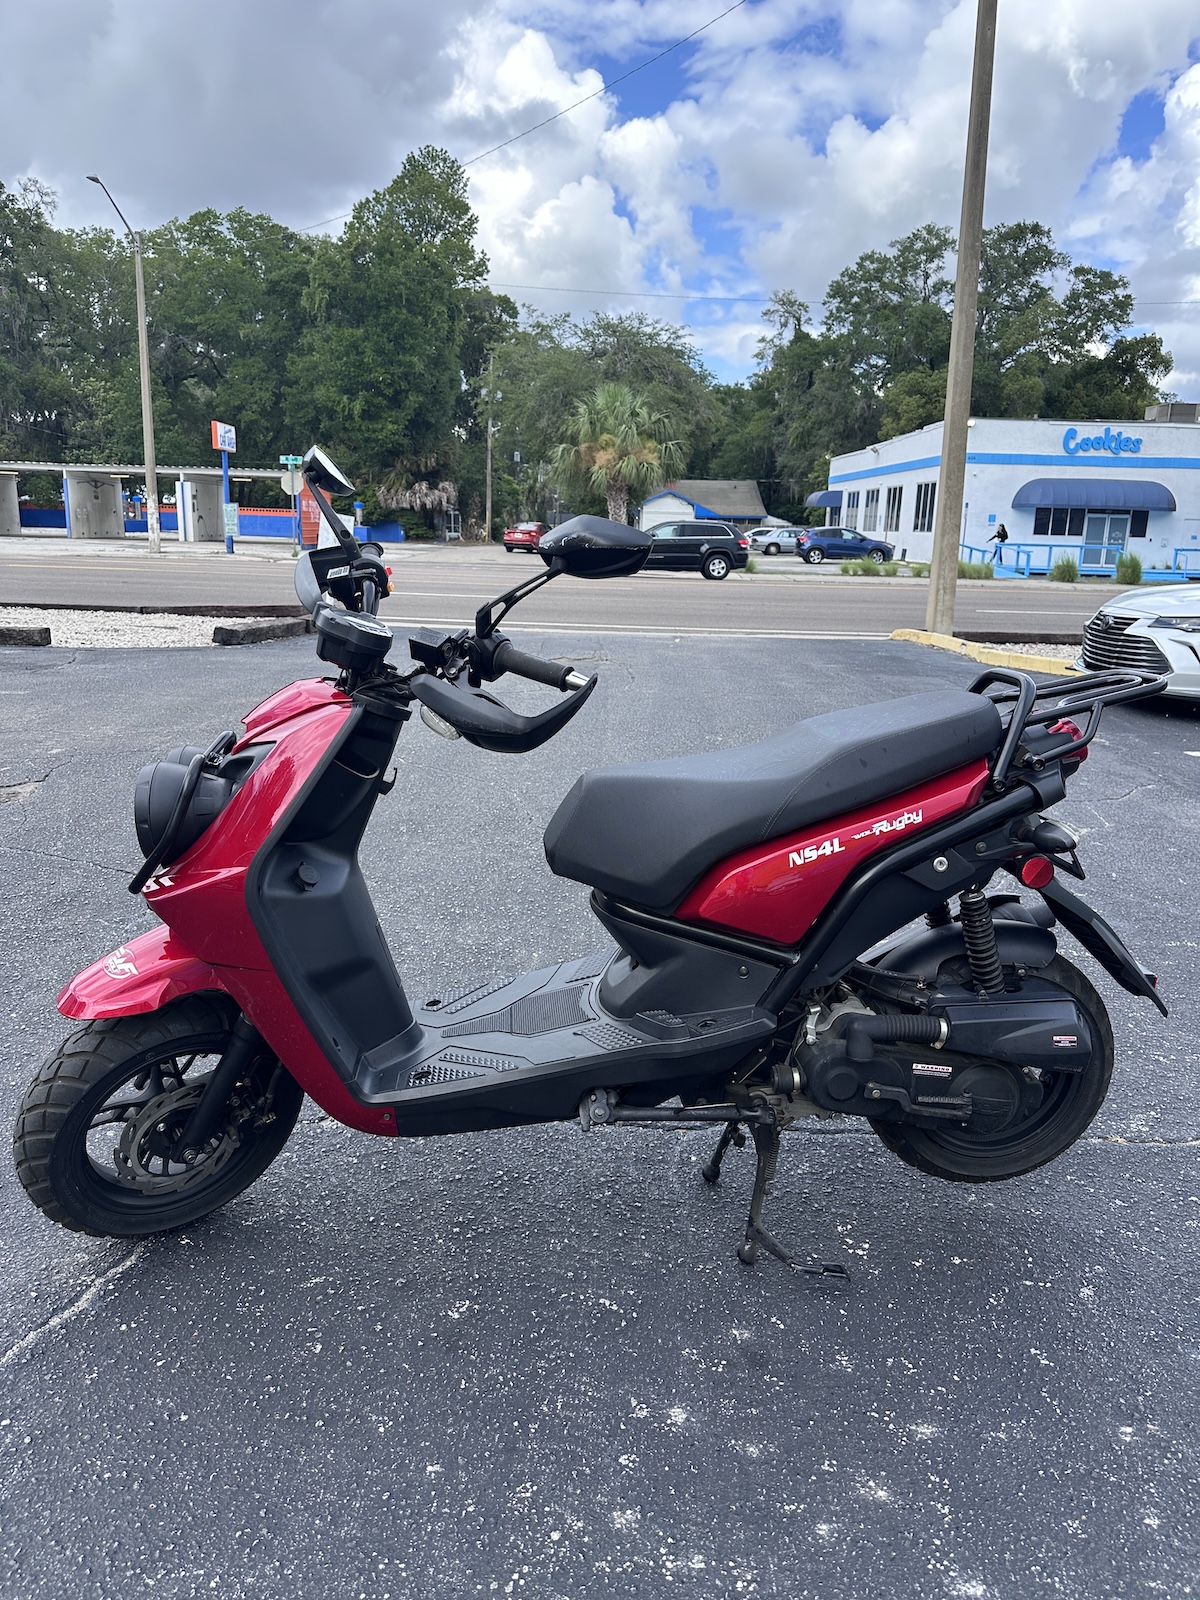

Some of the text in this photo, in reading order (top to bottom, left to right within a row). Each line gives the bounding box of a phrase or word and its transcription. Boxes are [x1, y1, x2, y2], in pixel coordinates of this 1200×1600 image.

[1063, 427, 1143, 455] Cookies
[872, 809, 922, 836] Rugby
[789, 837, 846, 868] NS4L
